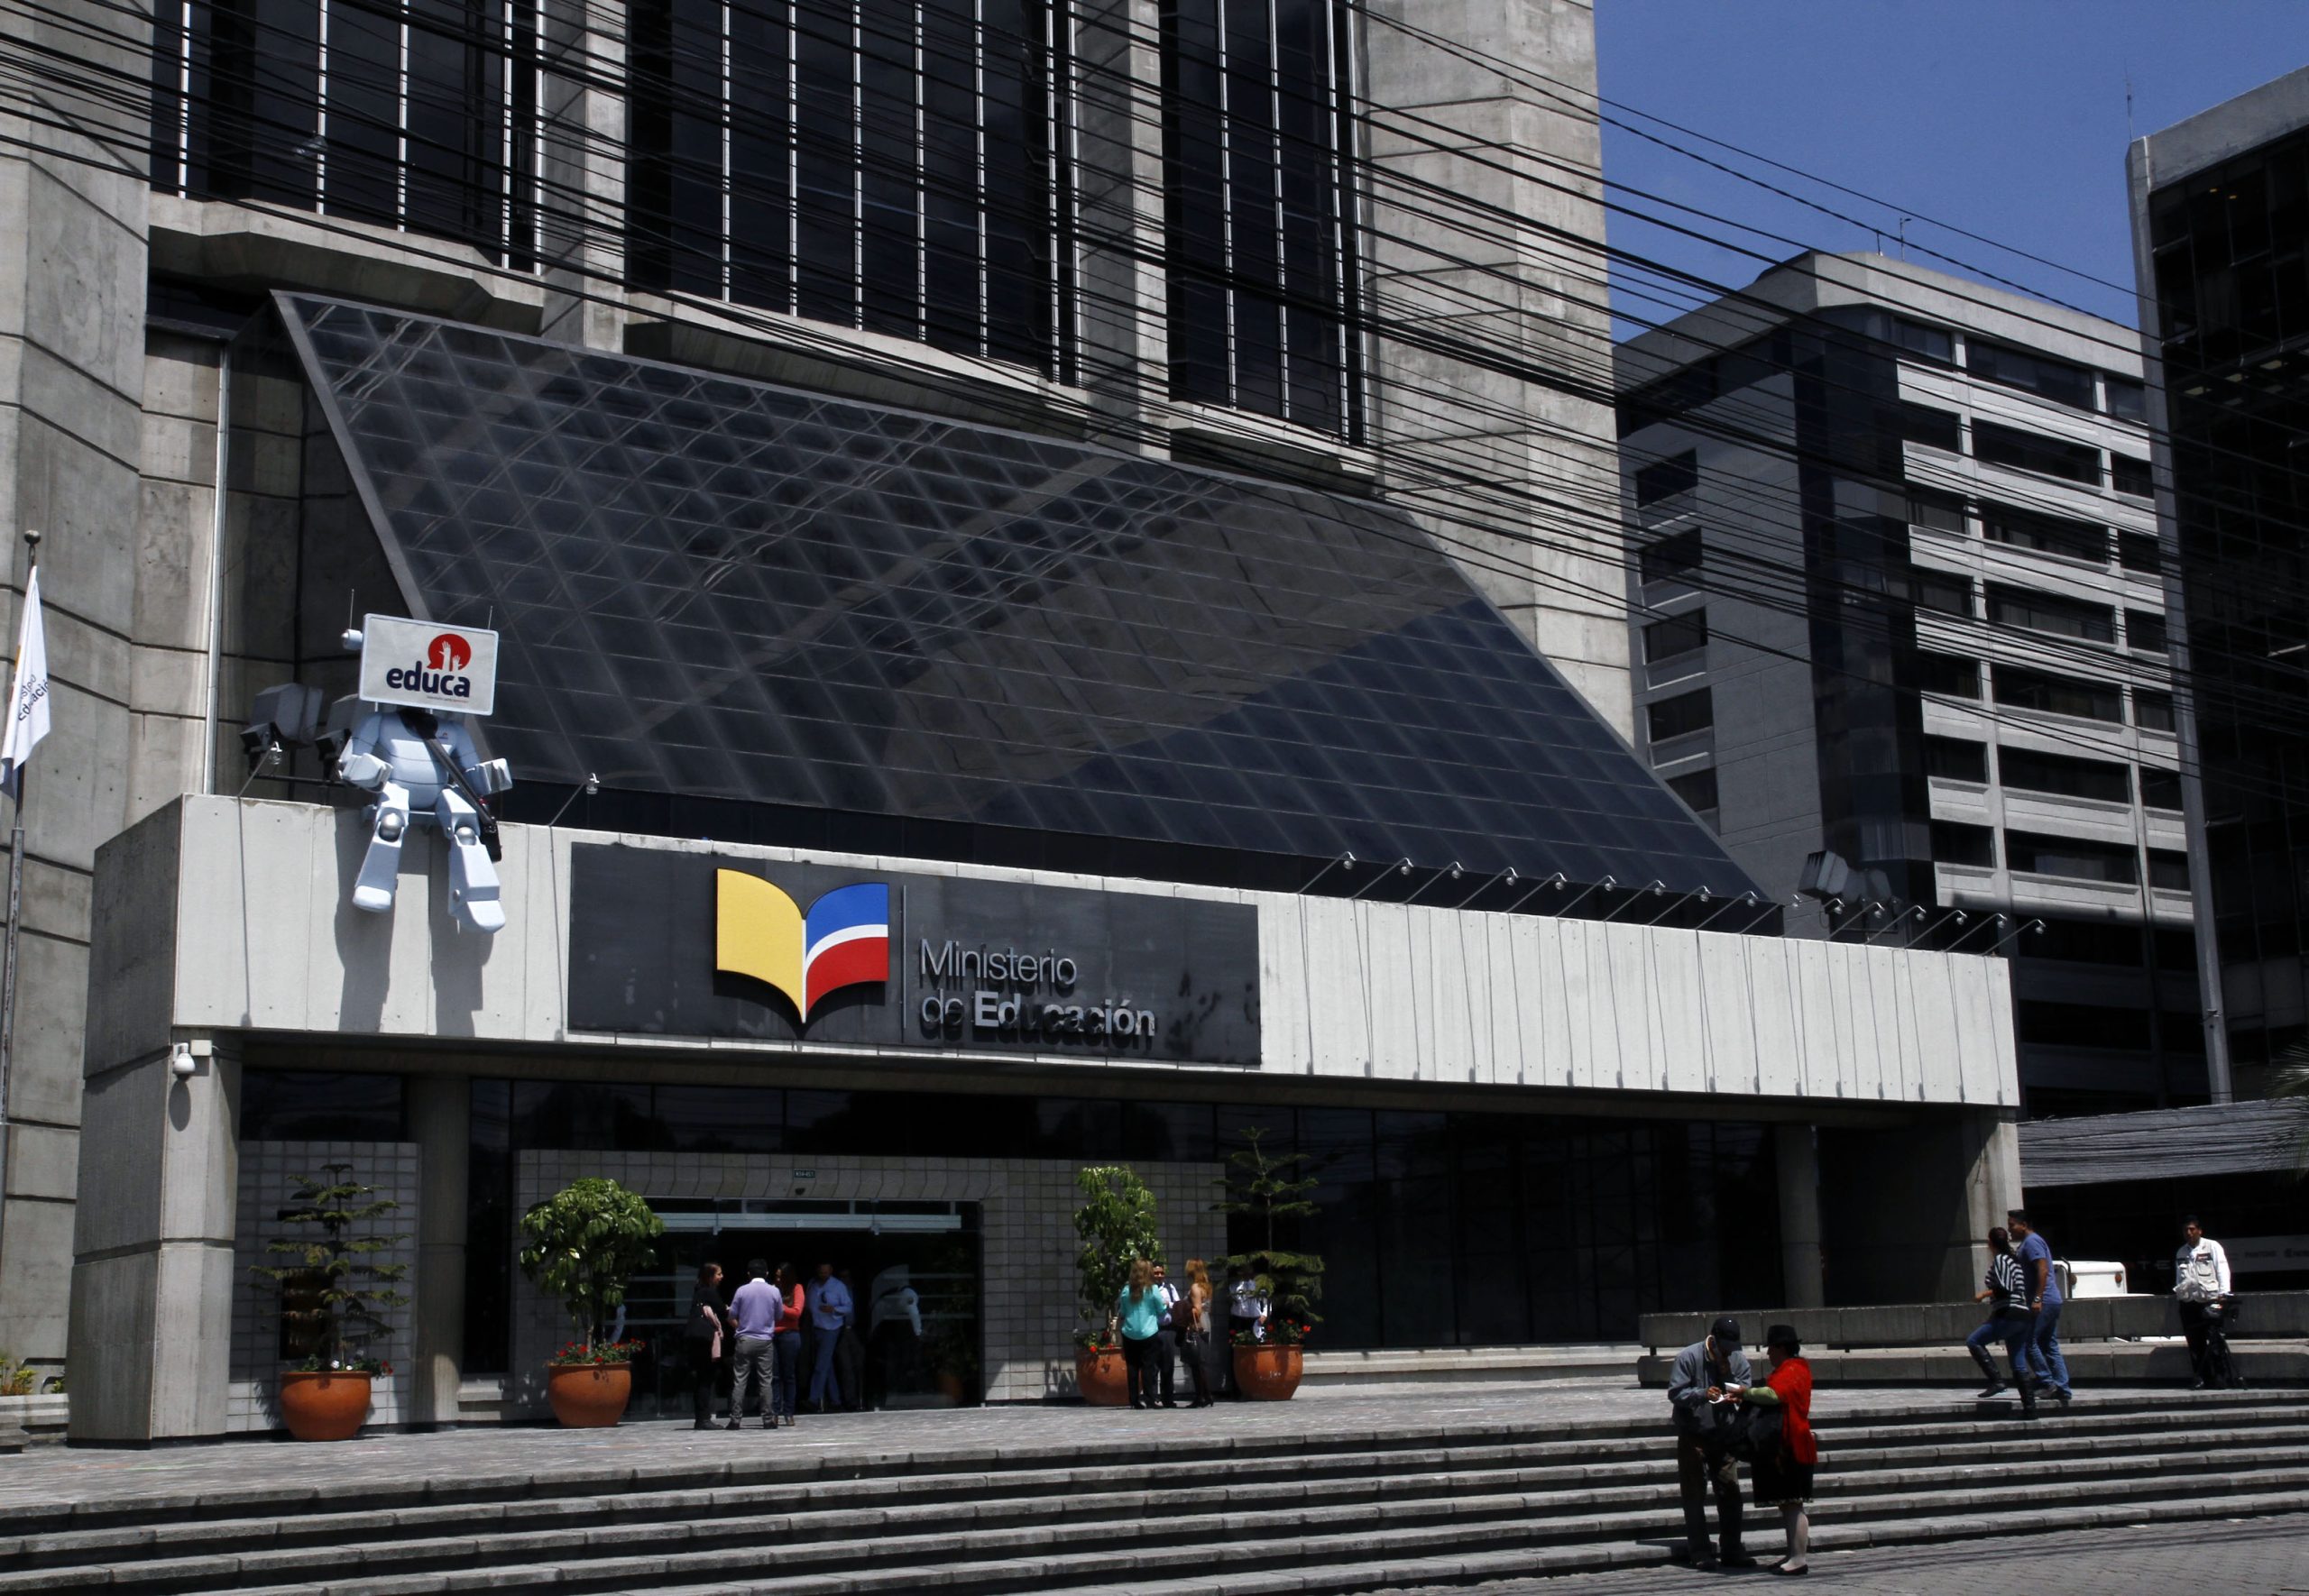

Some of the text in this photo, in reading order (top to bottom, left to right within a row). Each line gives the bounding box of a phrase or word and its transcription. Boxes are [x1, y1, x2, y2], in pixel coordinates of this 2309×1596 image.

[386, 660, 470, 697] educa
[921, 939, 1078, 986] Ministerio
[922, 988, 963, 1025] de
